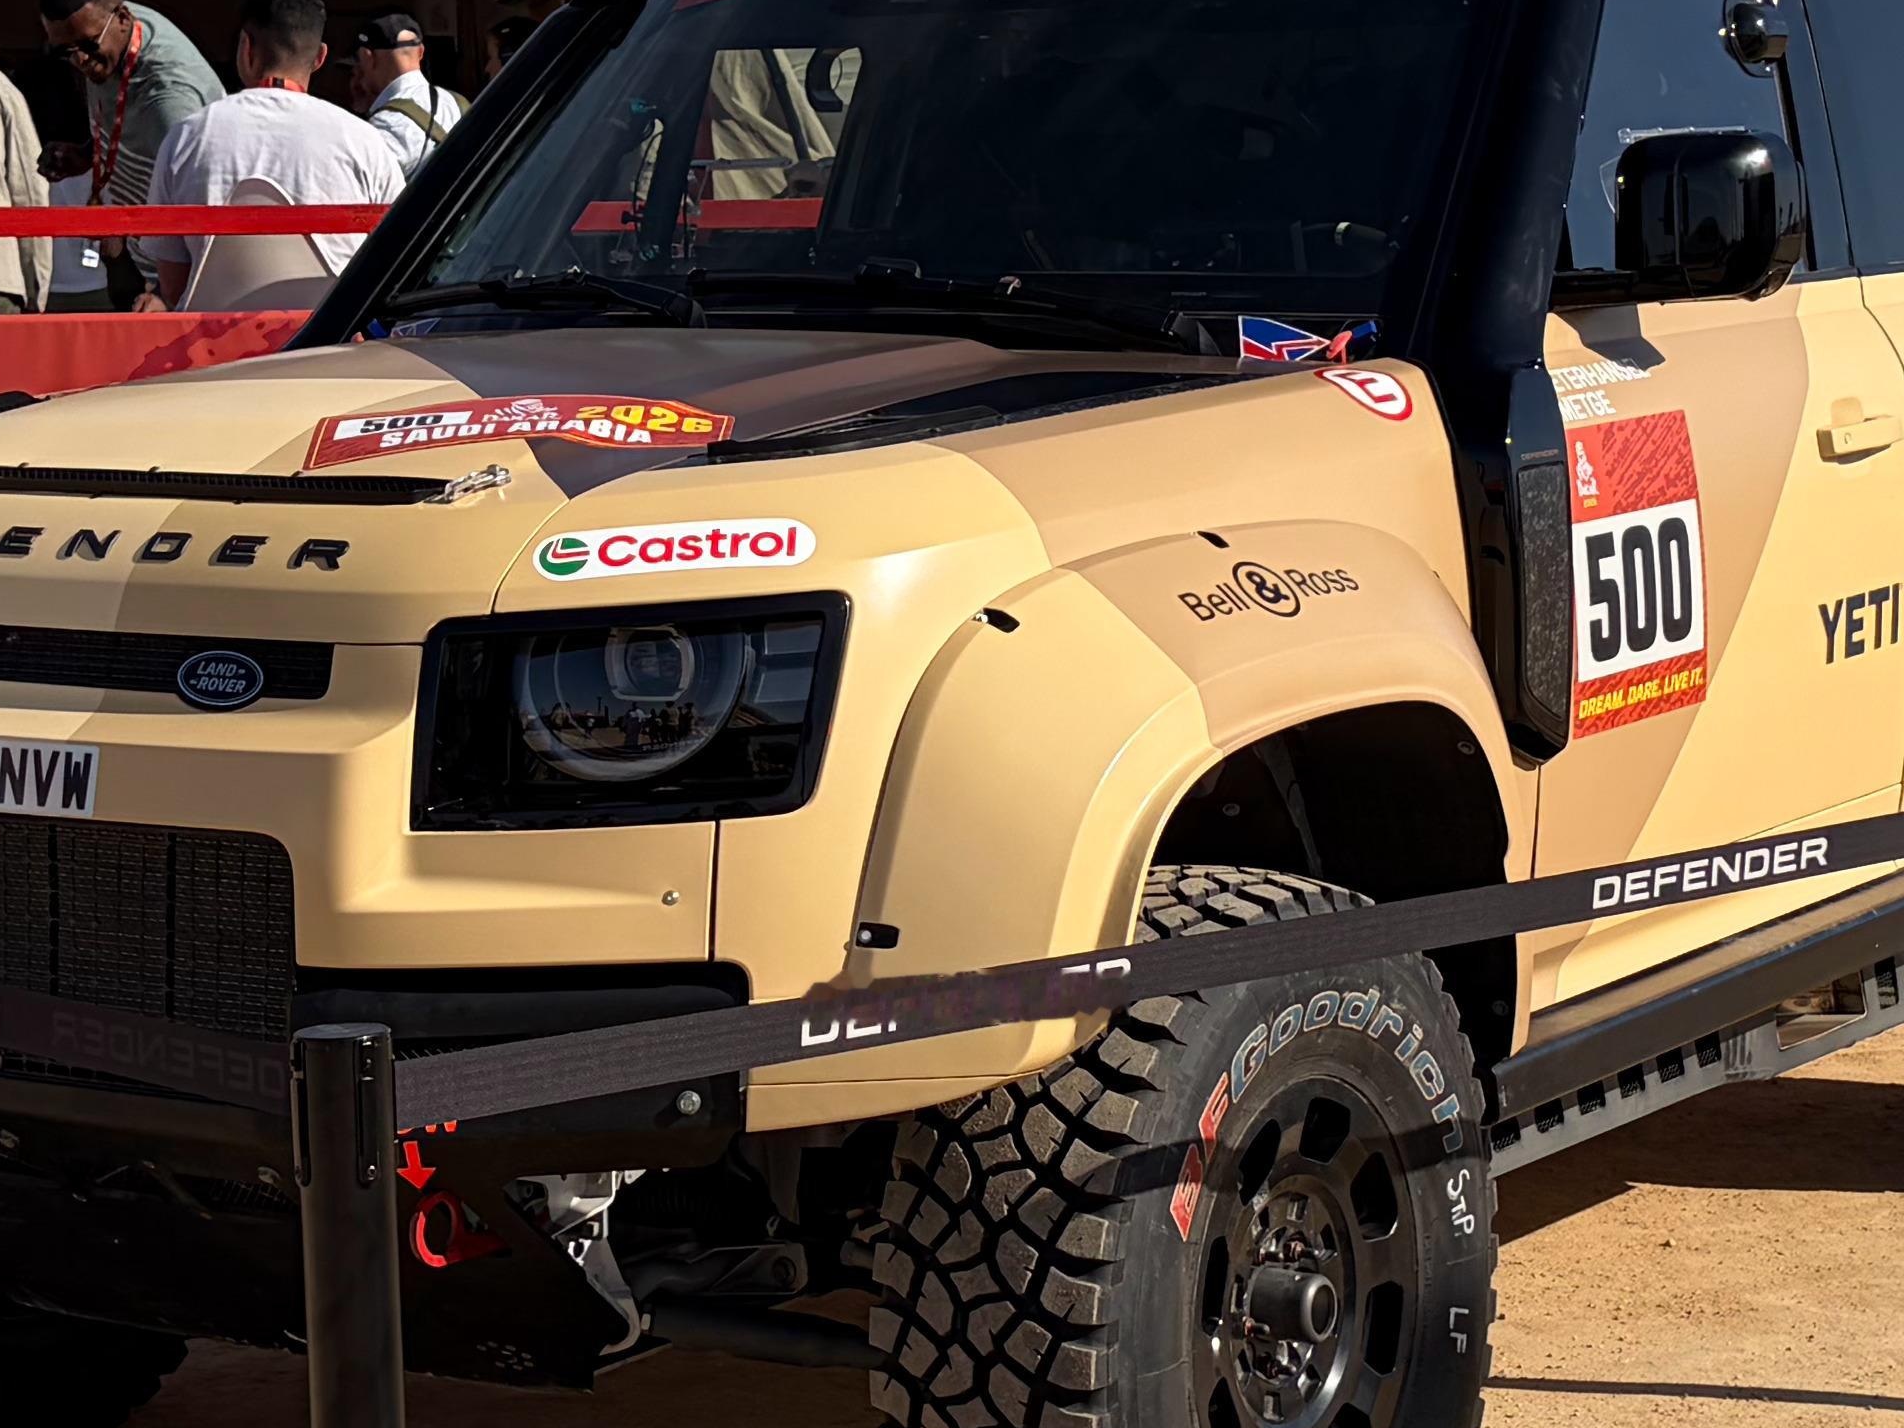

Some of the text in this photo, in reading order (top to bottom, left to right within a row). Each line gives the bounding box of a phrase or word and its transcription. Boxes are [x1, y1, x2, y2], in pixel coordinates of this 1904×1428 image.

[360, 414, 444, 434] 500
[576, 404, 714, 434] 2026
[379, 418, 652, 449] SAUDI ARABIA
[598, 527, 797, 567] Castrol
[1178, 569, 1360, 622] Bell & Ross
[1585, 517, 1693, 663] 500
[1818, 582, 1902, 665] YETI
[197, 661, 238, 677] LAND
[1578, 691, 1626, 720] DREAM.
[1627, 680, 1662, 704] DARE.
[1663, 671, 1690, 692] LIVE
[1592, 836, 1829, 910] DEFENDER
